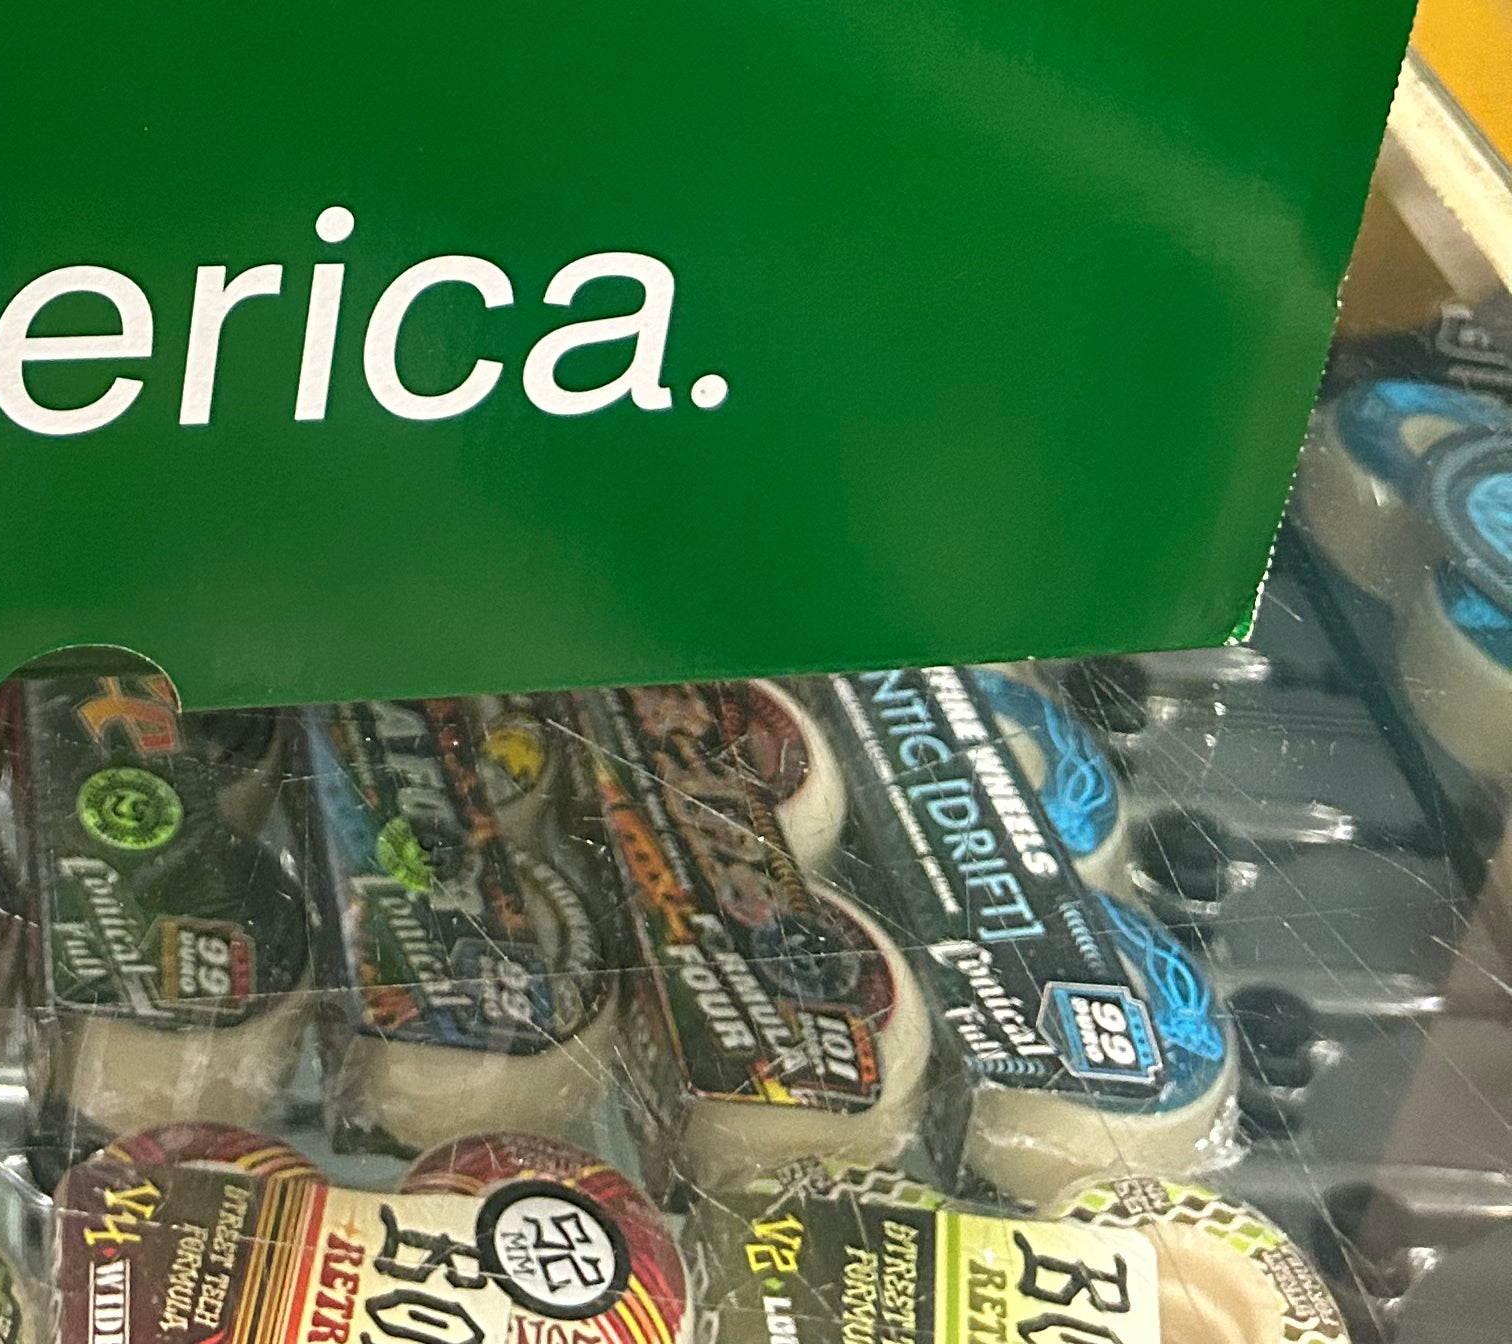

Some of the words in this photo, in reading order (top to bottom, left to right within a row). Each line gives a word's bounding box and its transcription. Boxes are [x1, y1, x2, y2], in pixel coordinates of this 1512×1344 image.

[178, 929, 196, 994] DURO
[197, 935, 232, 995] 99
[666, 944, 757, 1050] FOUR
[816, 1015, 859, 1082] 101
[1091, 1001, 1137, 1065] 99
[159, 1223, 210, 1332] FORMULA
[500, 1231, 537, 1276] MM
[193, 1273, 231, 1330] TECH
